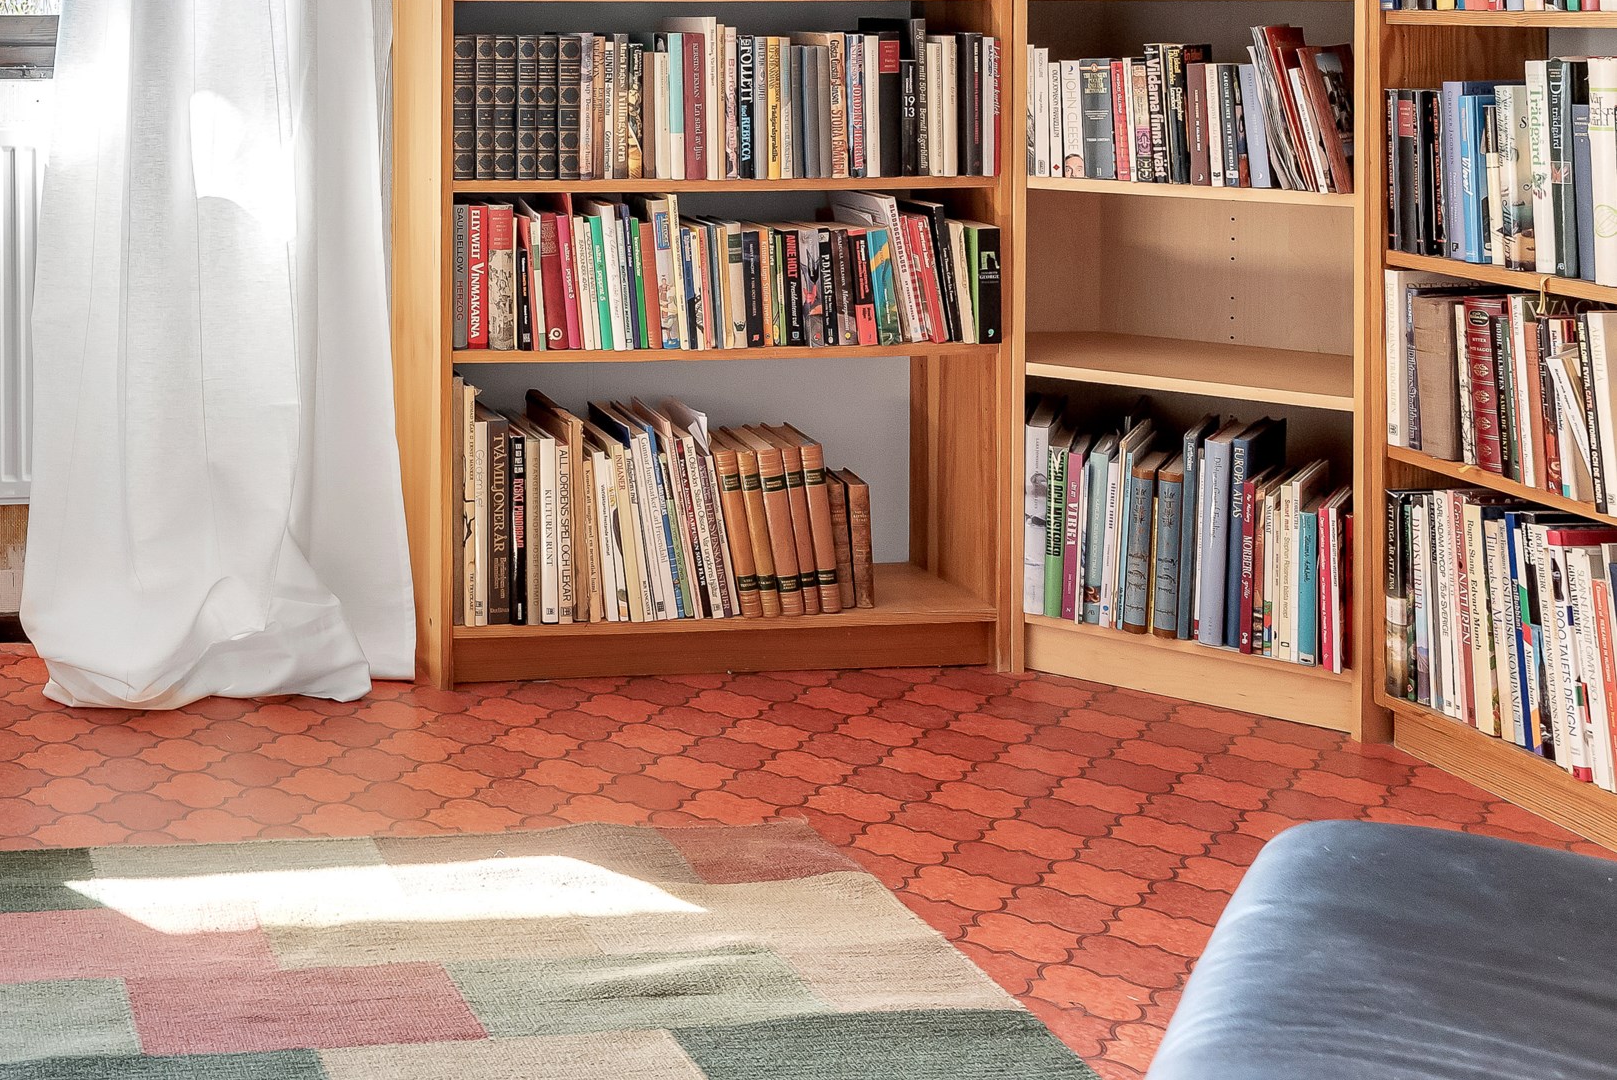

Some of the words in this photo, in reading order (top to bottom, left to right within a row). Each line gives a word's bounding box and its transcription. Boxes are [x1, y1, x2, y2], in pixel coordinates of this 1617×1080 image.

[741, 46, 752, 103] FOLLETT
[1146, 58, 1160, 112] Vildarna
[904, 96, 916, 106] 19
[1064, 78, 1077, 109] JOHN
[1550, 80, 1563, 105] Din
[694, 103, 702, 116] En
[832, 110, 842, 138] STORA
[904, 107, 915, 117] 13
[742, 117, 750, 161] REBECCA
[1068, 112, 1079, 150] CLEESE
[1151, 114, 1164, 144] finns
[1551, 107, 1562, 149] trädgård
[1153, 152, 1167, 177] väst
[472, 210, 480, 233] ELLY
[472, 233, 480, 259] WELT
[786, 235, 796, 256] ANNE
[787, 258, 797, 278] HOLT
[493, 433, 506, 461] TVÅ
[559, 450, 569, 469] ALL
[615, 454, 625, 491] INDIANER
[1234, 447, 1245, 485] EUROPA
[559, 471, 569, 516] JORDENS
[640, 437, 651, 466] Gunnar
[652, 509, 664, 525] Carl
[491, 462, 505, 534] MILJONER
[1232, 489, 1243, 518] ATLAS
[544, 489, 553, 538] KULTUREN
[494, 534, 507, 553] ÅR
[560, 518, 570, 544] SPEL
[1466, 519, 1475, 549] Ragna
[545, 541, 554, 567] RUNT
[561, 545, 570, 567] OCH
[1437, 549, 1447, 578] NYCOP
[562, 569, 571, 601] LEKAR
[1469, 579, 1479, 616] Edvard
[1473, 618, 1482, 651] Munch
